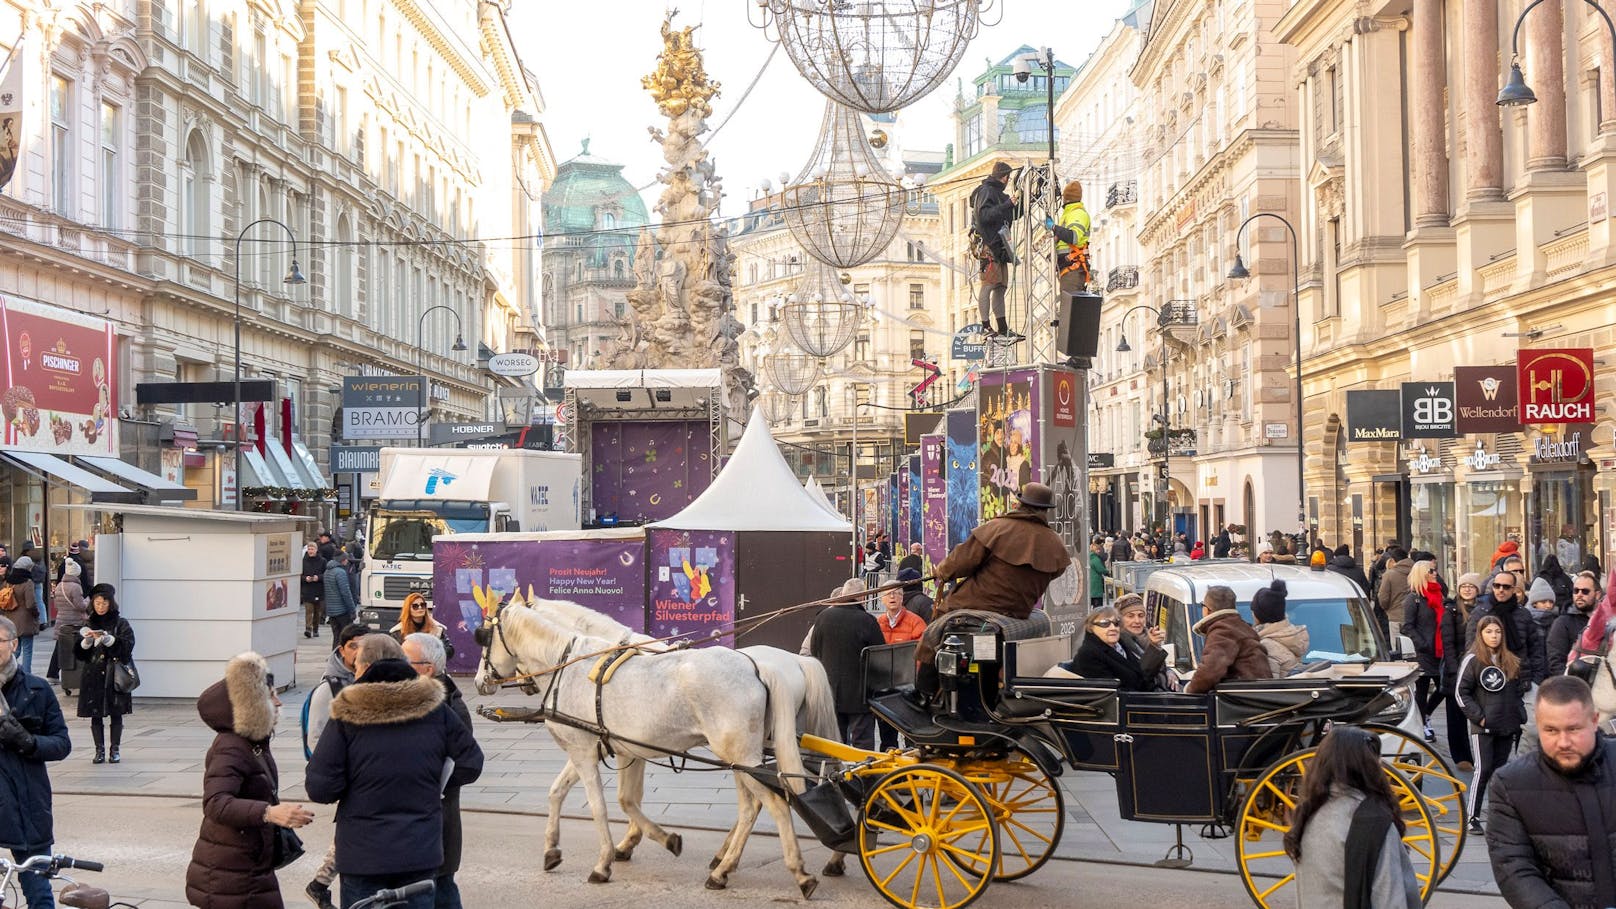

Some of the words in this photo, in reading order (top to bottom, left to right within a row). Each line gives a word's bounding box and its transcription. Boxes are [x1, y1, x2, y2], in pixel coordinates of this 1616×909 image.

[963, 345, 988, 353] BUFFE
[43, 355, 80, 372] PISCHINGER
[495, 358, 532, 367] WORSEG
[351, 382, 419, 392] wienerin
[1459, 405, 1518, 418] Wellendorf
[1525, 403, 1591, 419] RAUCH
[351, 410, 425, 426] BRAMO
[452, 426, 494, 434] HÜBNER
[1354, 427, 1400, 439] MaxMara
[1534, 432, 1580, 460] Wellendorff
[1055, 493, 1084, 519] DICH
[549, 568, 572, 576] Prosit
[573, 568, 608, 577] Neujahr!
[549, 577, 575, 586] Happy
[576, 577, 595, 585] New
[596, 577, 617, 585] Year!
[549, 586, 572, 594] Felice
[572, 586, 594, 594] Anno
[594, 586, 624, 594] Nuovo!
[655, 599, 697, 610] Wiener
[655, 610, 730, 624] Silvesterpfad
[1060, 622, 1076, 635] 2025
